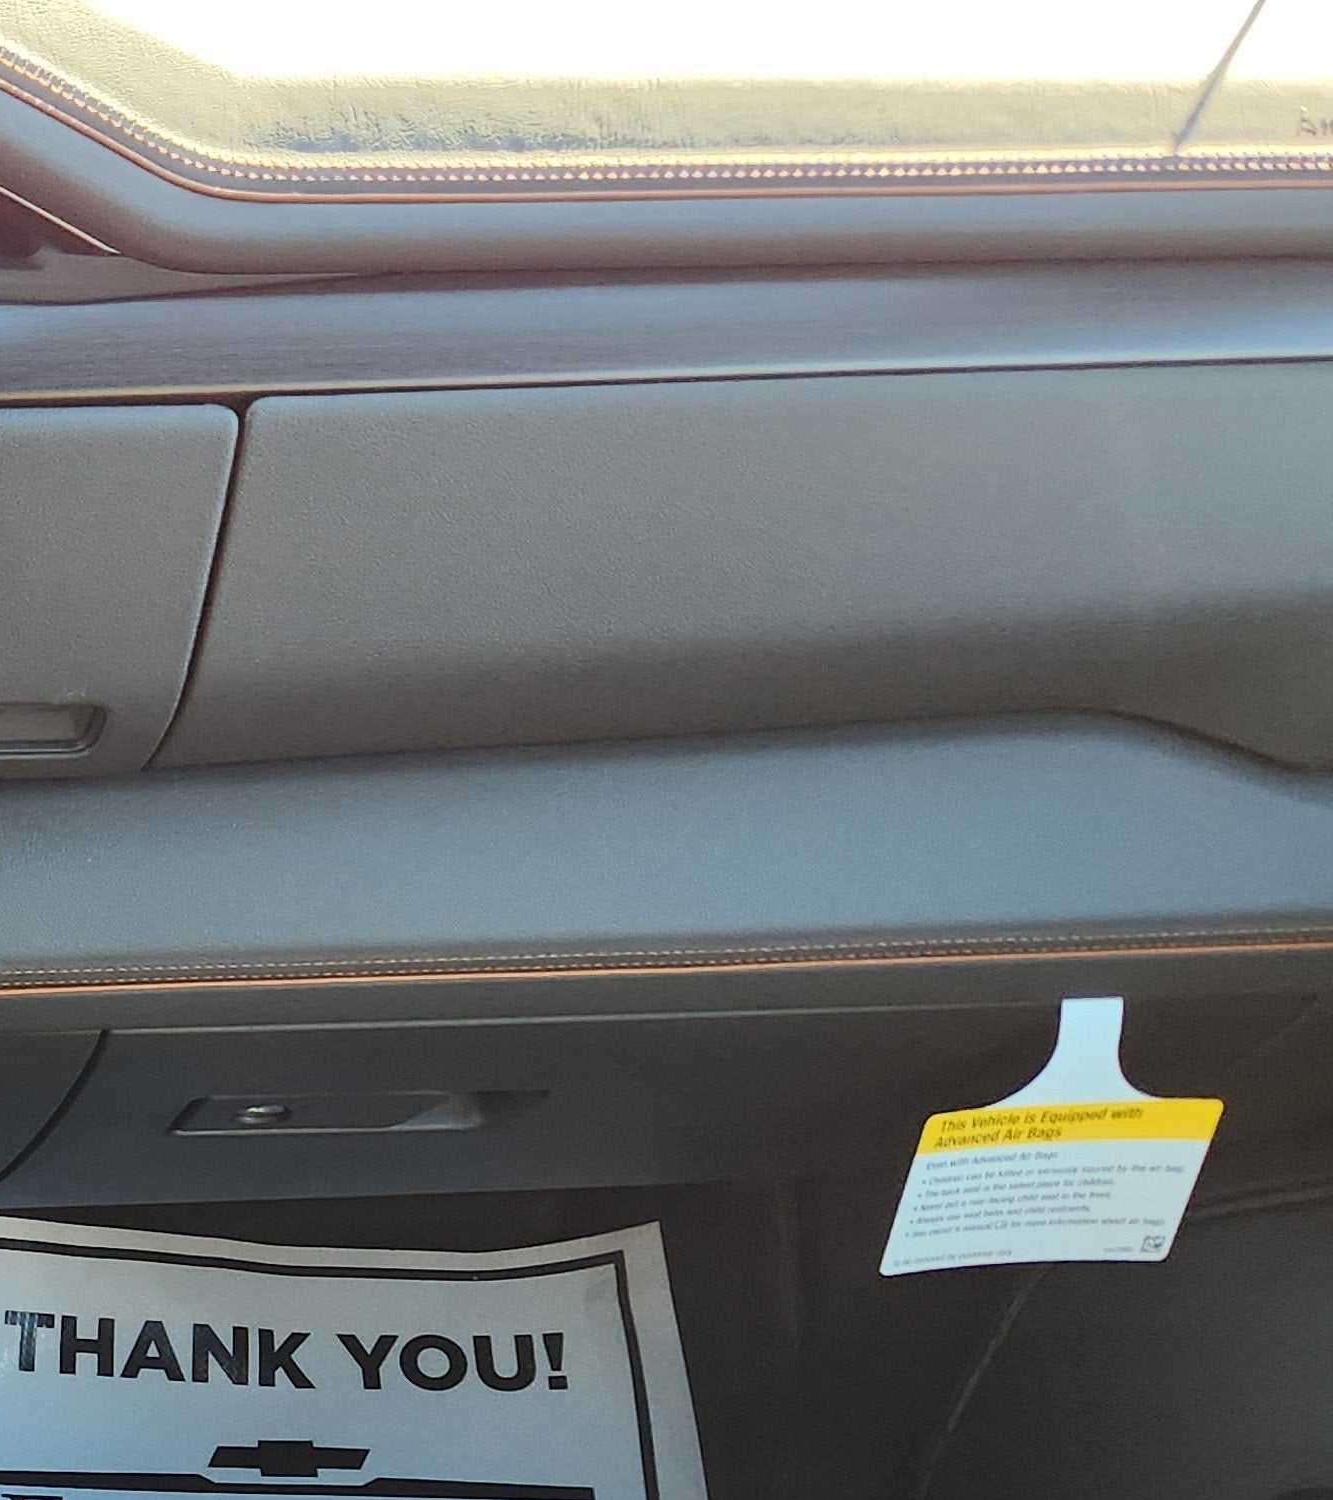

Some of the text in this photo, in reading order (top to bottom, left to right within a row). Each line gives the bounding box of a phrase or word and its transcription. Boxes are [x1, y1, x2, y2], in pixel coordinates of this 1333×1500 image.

[941, 1107, 1143, 1132] This Vehicle is Equipped with
[933, 1126, 1063, 1148] Advanced Air Bags
[4, 1309, 568, 1393] THANK YOU!
